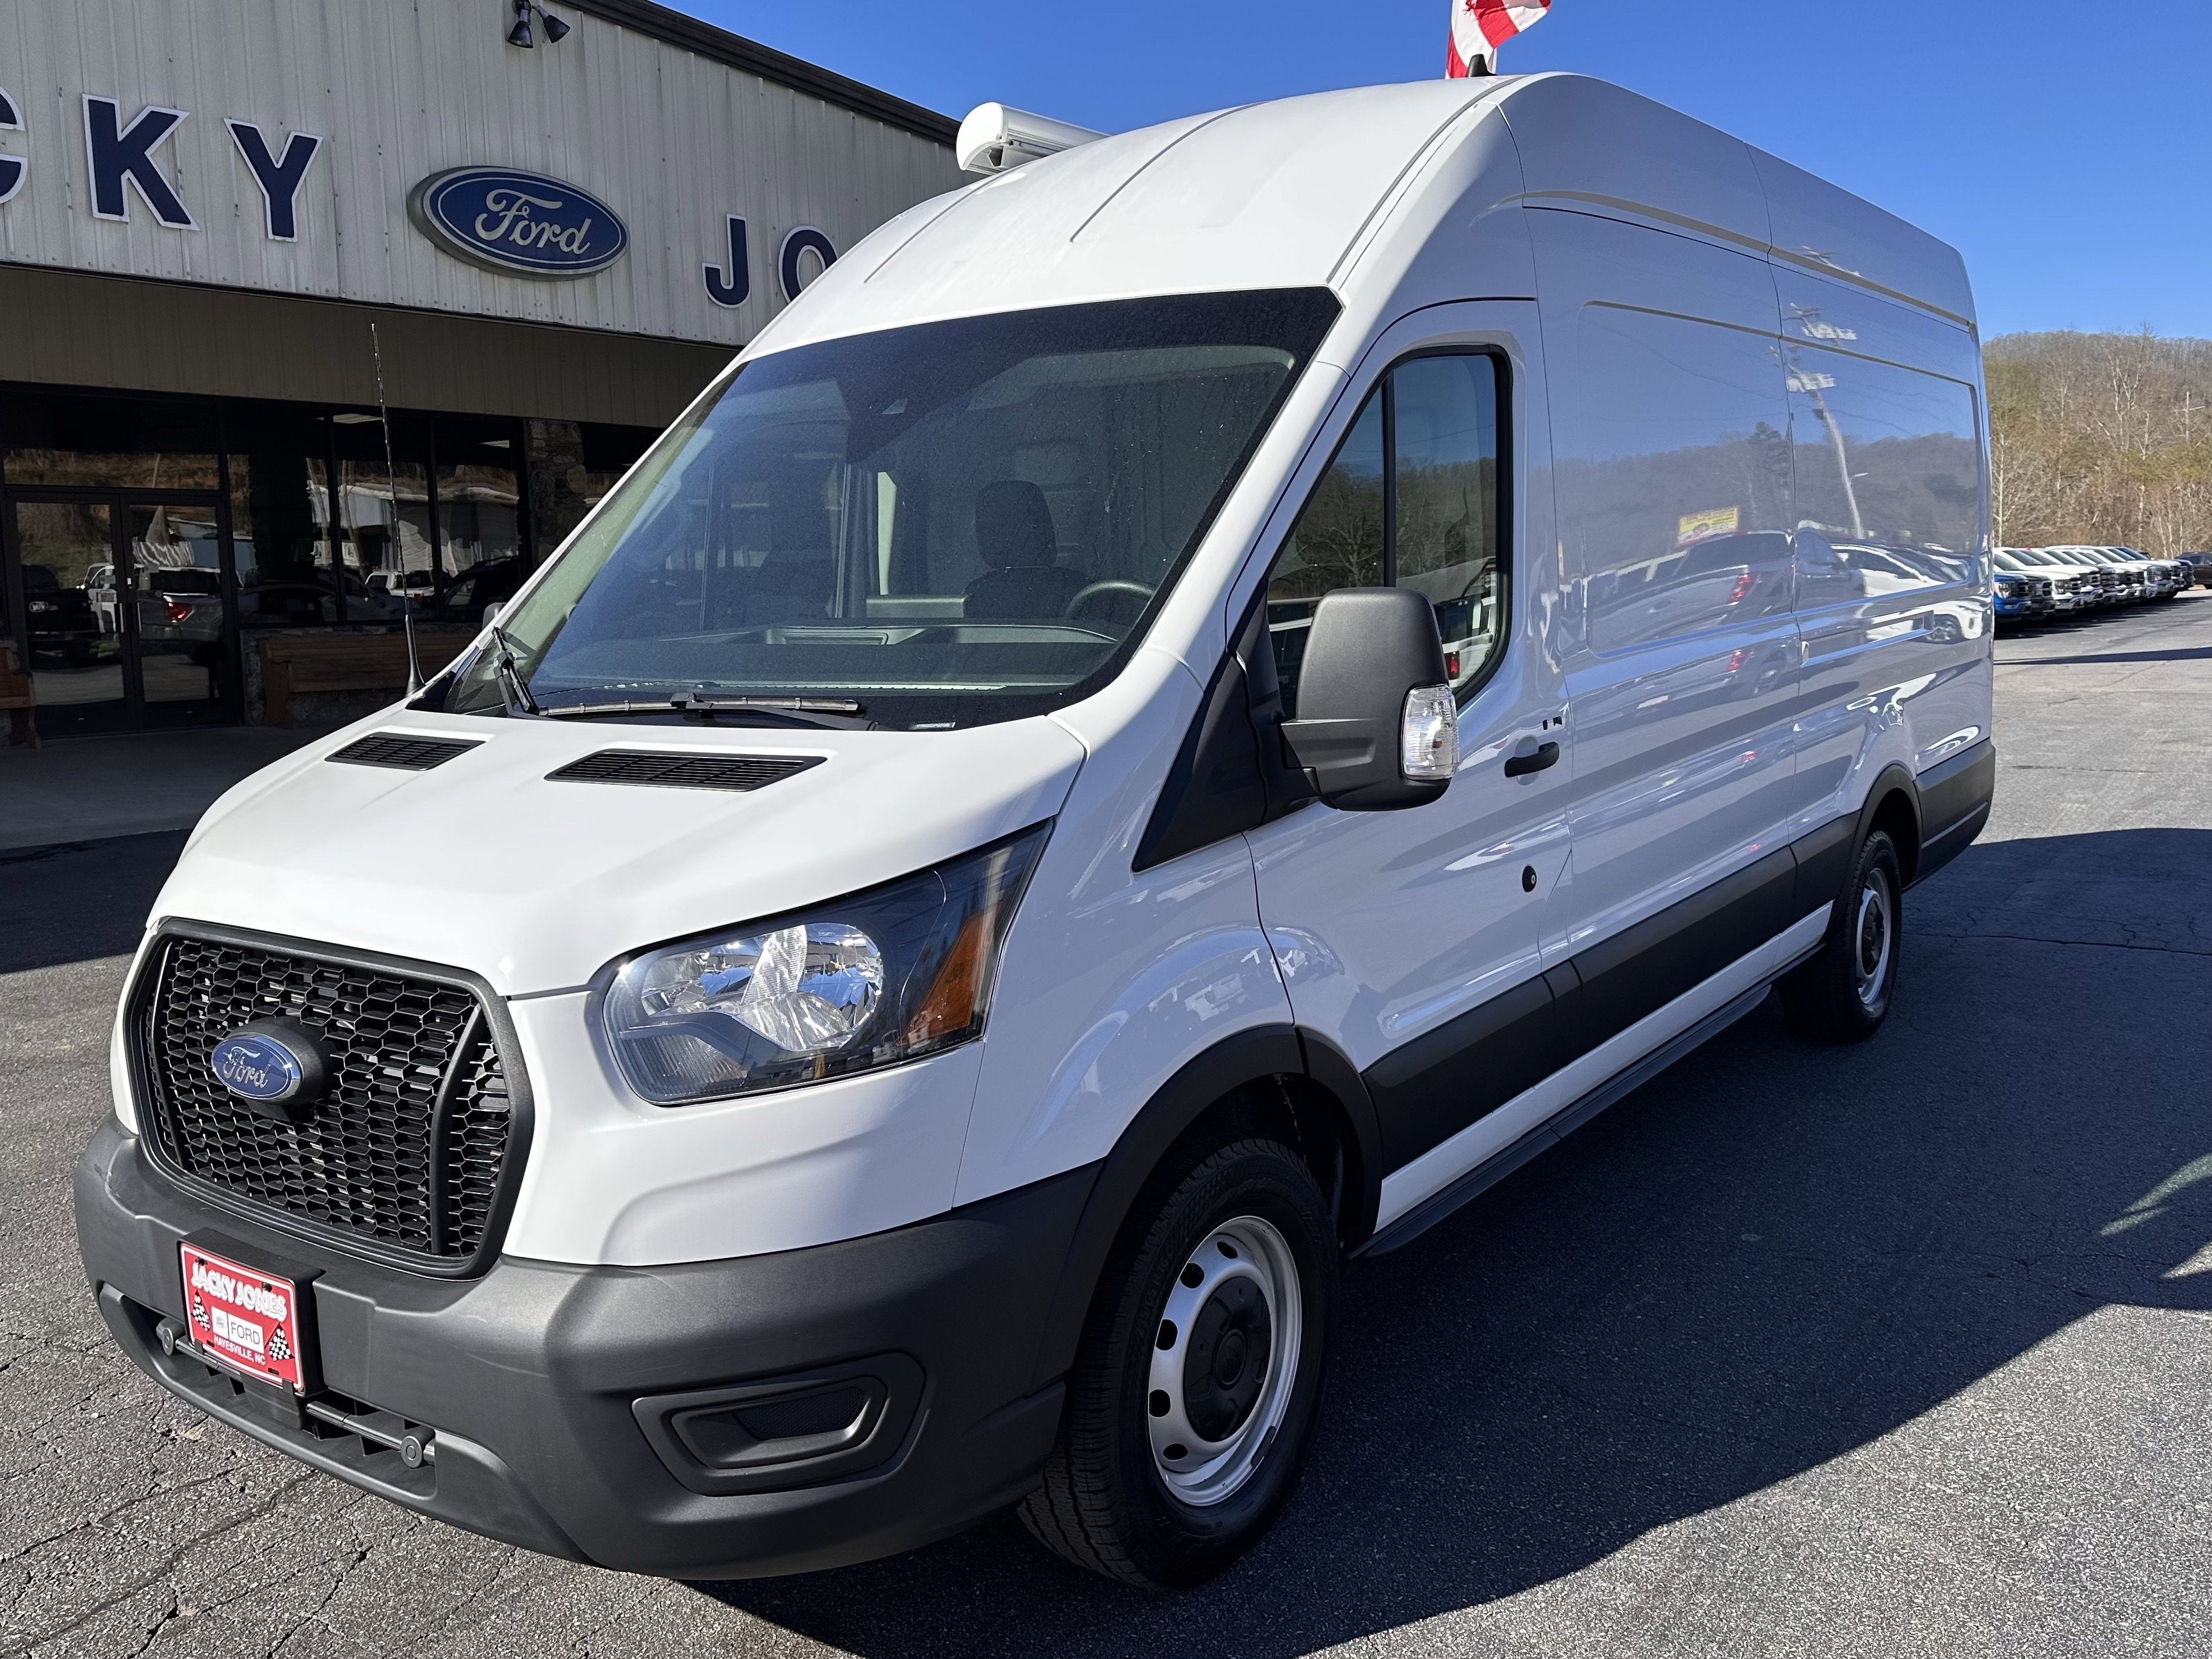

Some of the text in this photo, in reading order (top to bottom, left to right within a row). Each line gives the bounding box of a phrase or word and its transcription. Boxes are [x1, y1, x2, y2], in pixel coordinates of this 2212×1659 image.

[474, 188, 592, 255] Ford
[223, 1046, 271, 1088] Ford
[191, 1262, 287, 1322] JACKY JONES
[230, 1322, 261, 1345] FORD
[254, 1352, 266, 1366] NC
